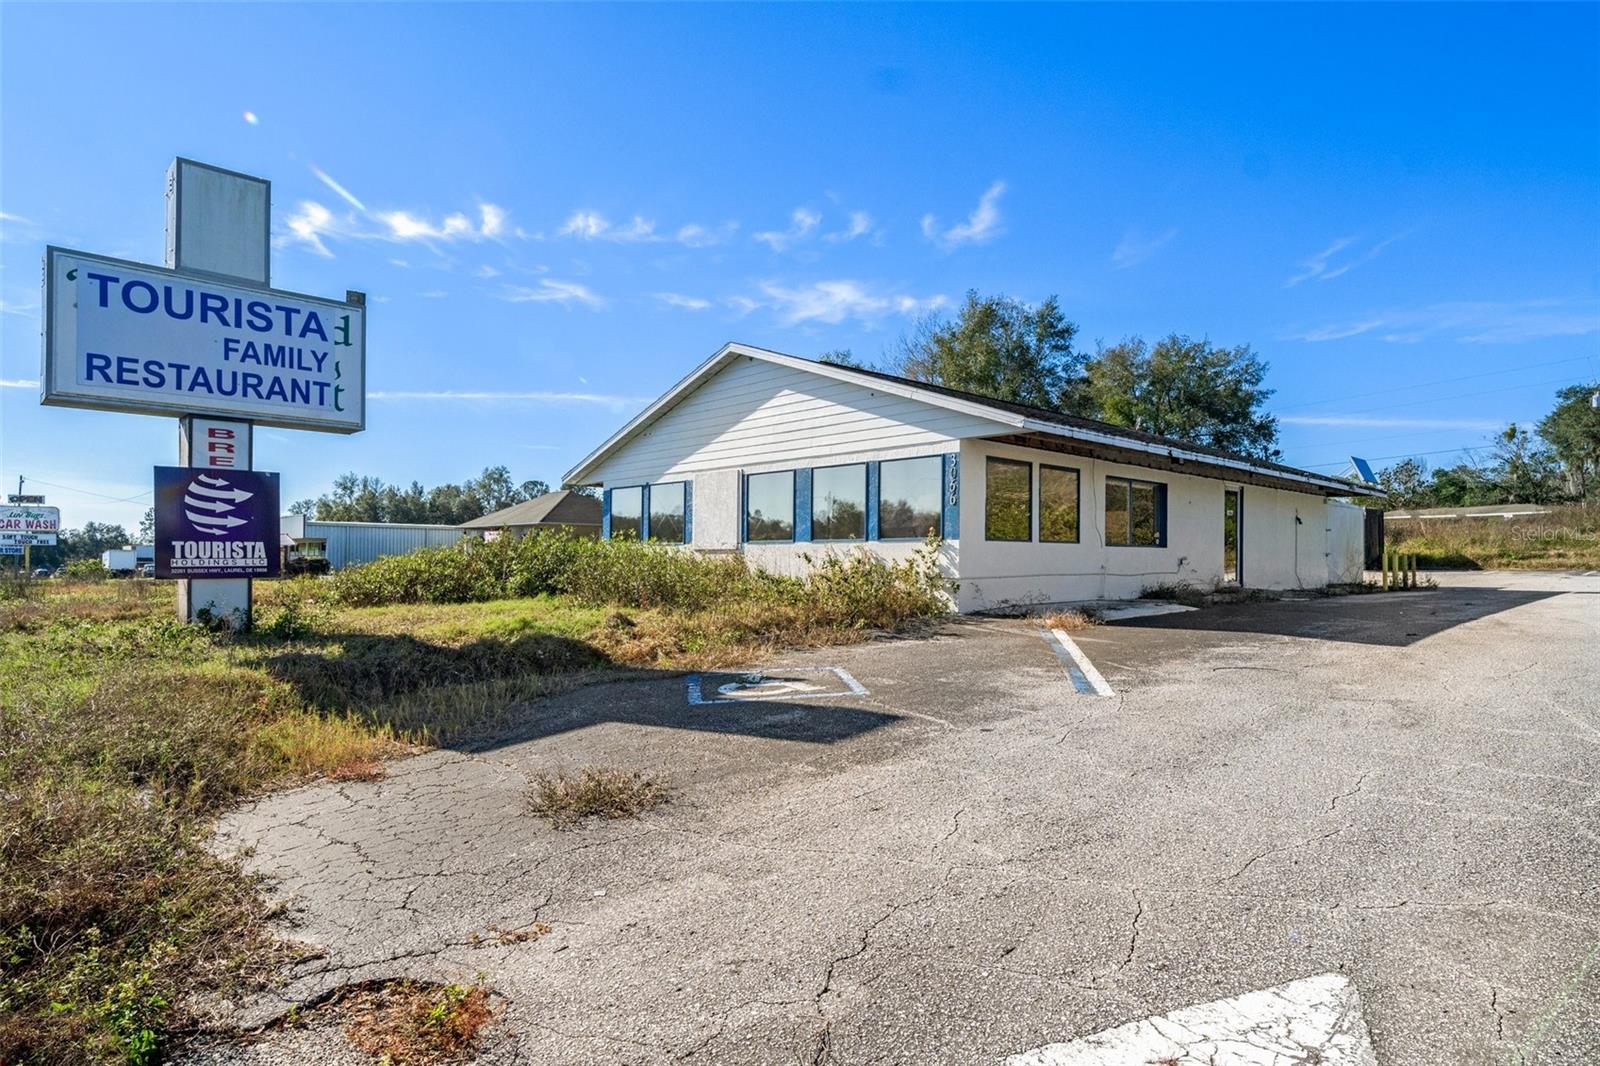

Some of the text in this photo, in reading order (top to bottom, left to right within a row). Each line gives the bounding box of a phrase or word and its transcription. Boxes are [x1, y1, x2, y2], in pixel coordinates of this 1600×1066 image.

[87, 272, 329, 342] TOURISTA
[223, 337, 329, 373] FAMILY
[85, 352, 331, 406] RESTAURANT
[949, 453, 958, 505] 3066
[0, 519, 56, 529] CAR WASH
[171, 541, 266, 559] TOURISTA
